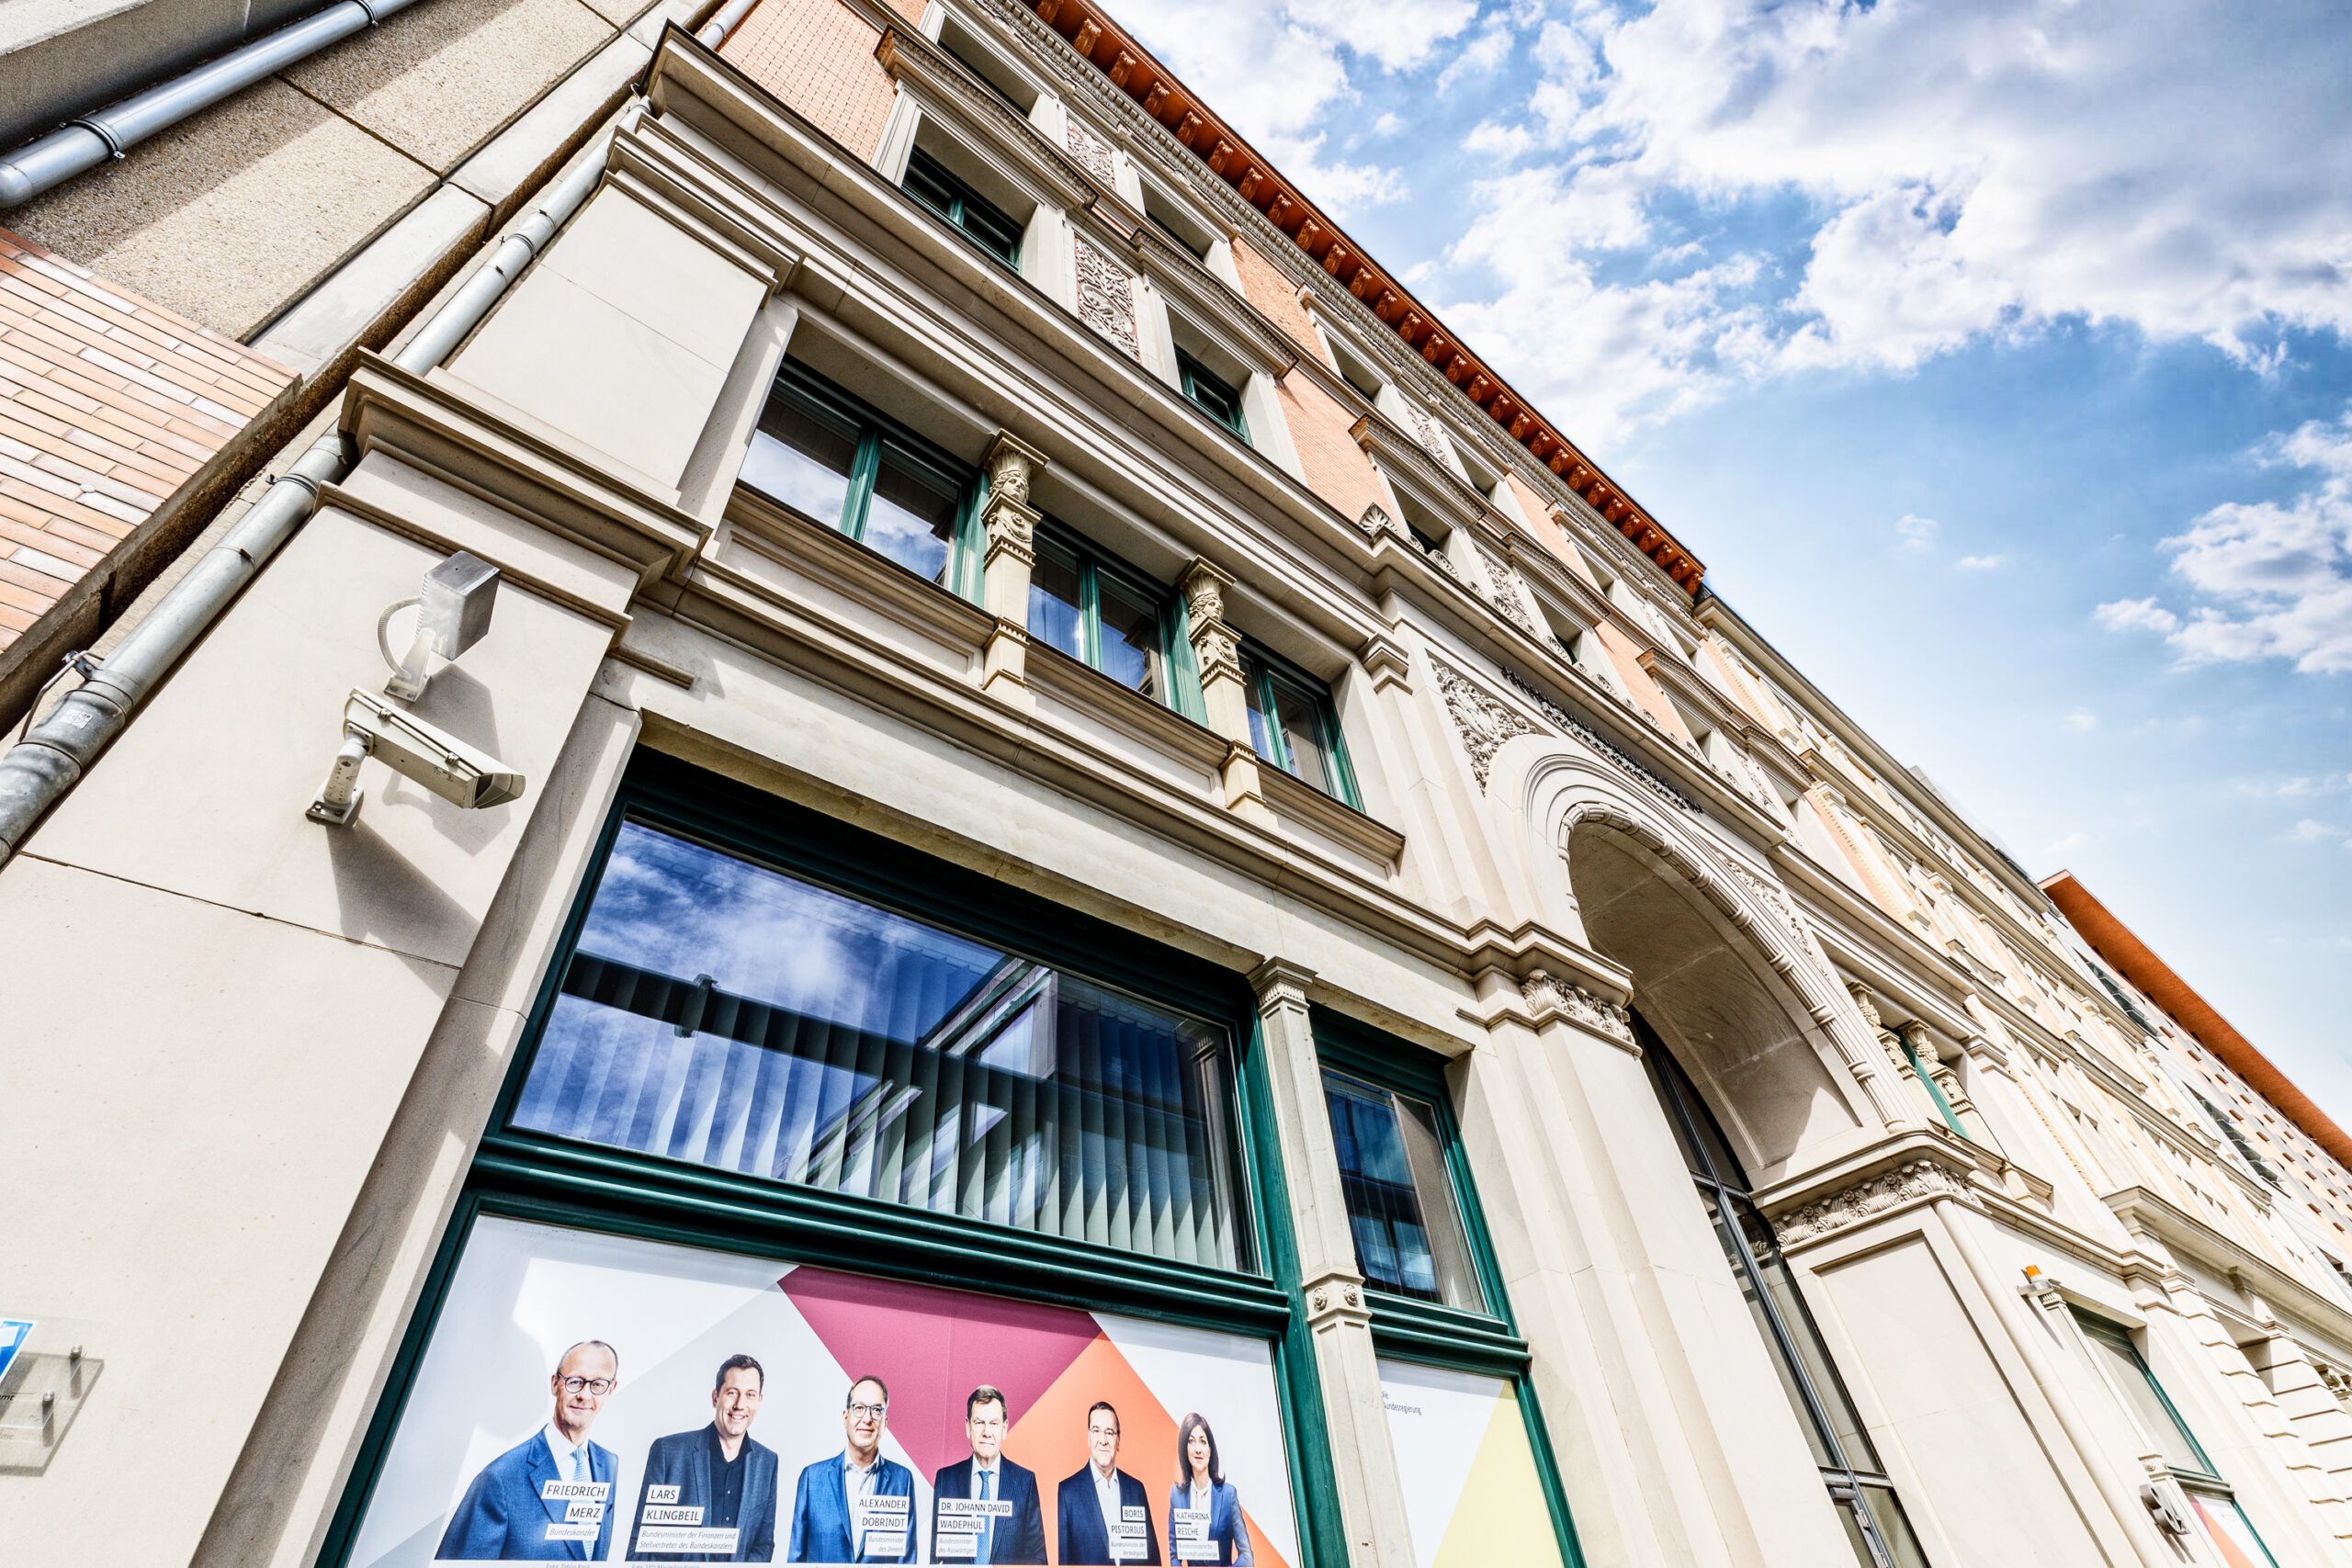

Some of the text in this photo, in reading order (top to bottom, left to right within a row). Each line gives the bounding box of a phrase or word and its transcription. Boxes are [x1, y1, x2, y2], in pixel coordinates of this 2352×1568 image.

[546, 1484, 605, 1497] FRIEDRICH
[650, 1489, 676, 1500] LARS
[858, 1498, 907, 1509] ALEXANDER
[941, 1502, 1011, 1513] DR. JOHANN DAVID
[569, 1507, 601, 1518] MERZ
[646, 1509, 699, 1521] KLINGBEIL
[1124, 1509, 1144, 1518] BORIS
[1176, 1512, 1210, 1521] KATHERINA
[862, 1517, 906, 1528] DOBRINDT
[940, 1519, 983, 1530] WADEPHUL
[549, 1528, 596, 1537] Bundeskanzler
[641, 1530, 686, 1539] Bundesminister
[698, 1531, 724, 1540] Finanzen
[1111, 1525, 1145, 1535] PISTORIUS
[1177, 1527, 1199, 1536] REICHE
[639, 1540, 733, 1551] Stellvertreter des Bundeskanzlers
